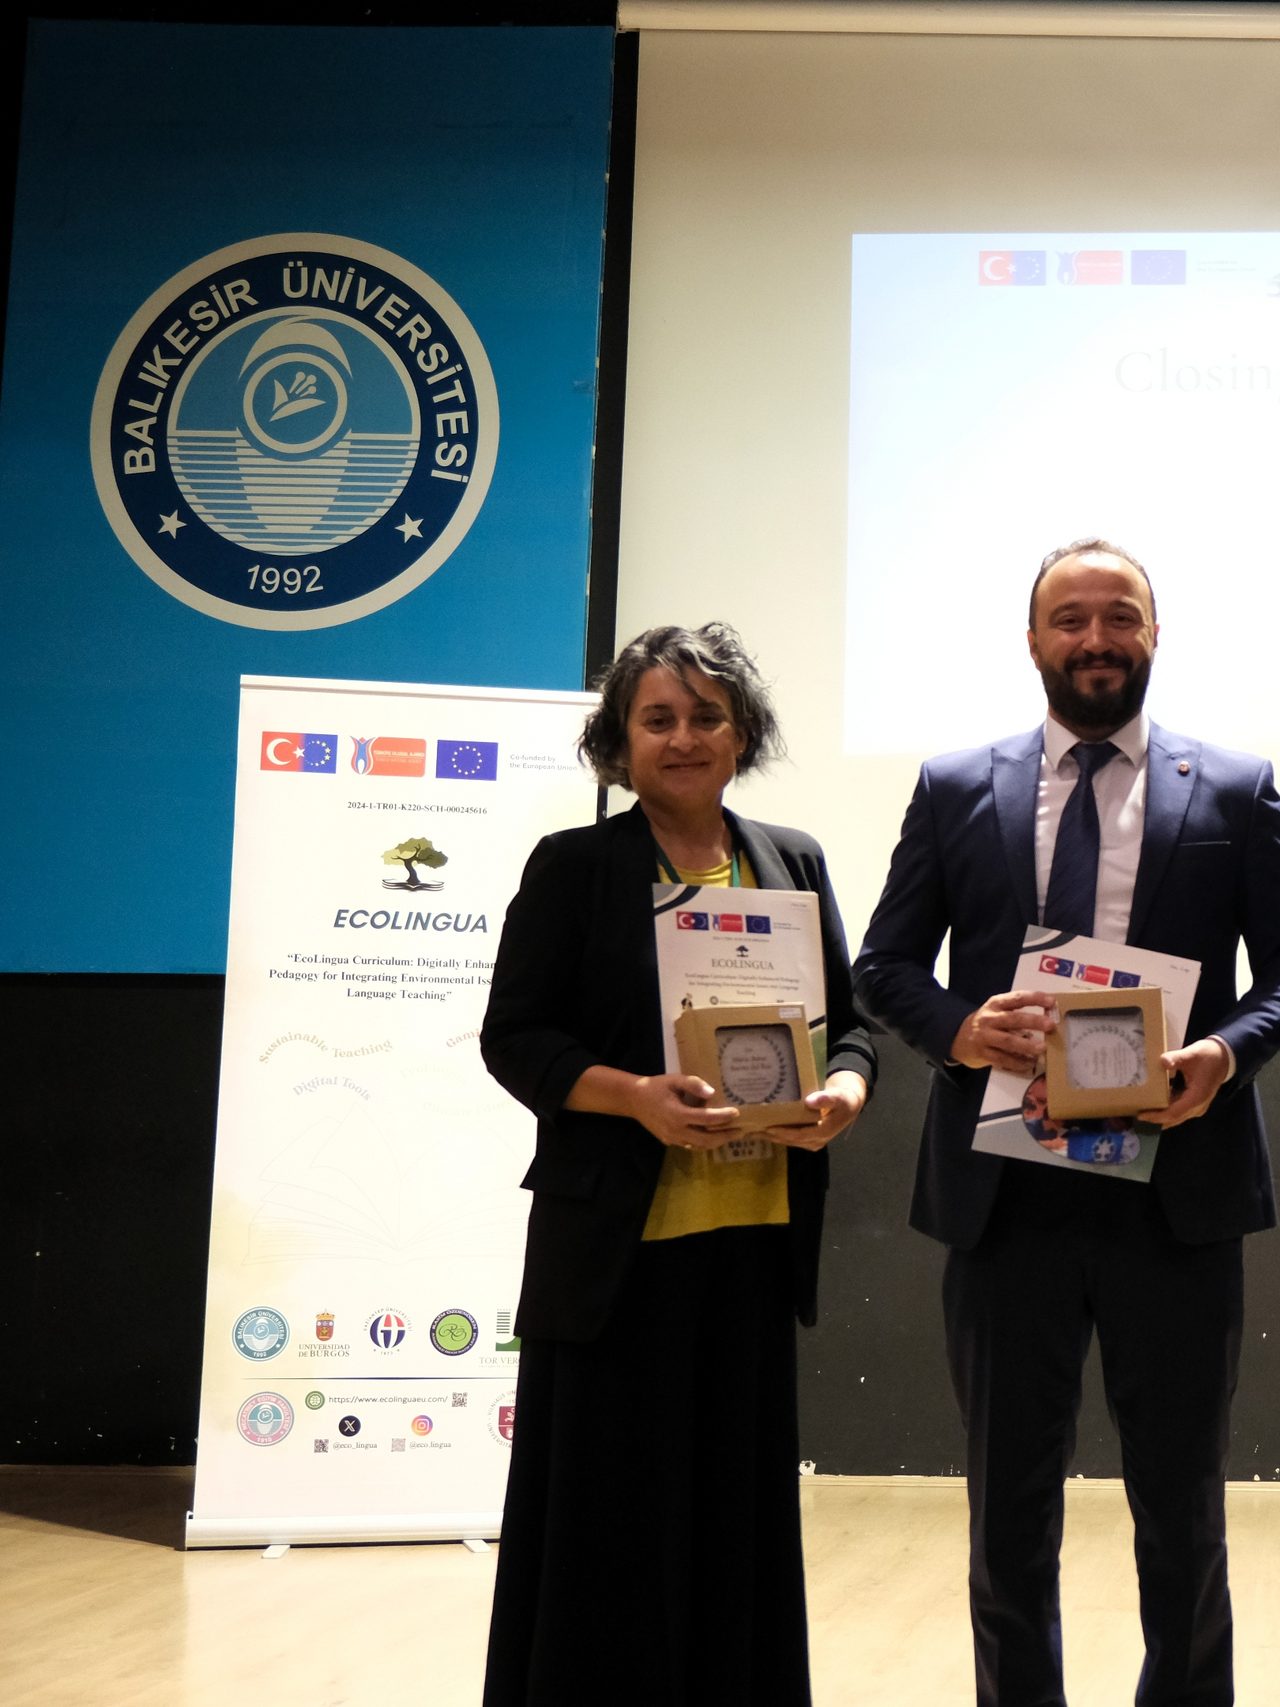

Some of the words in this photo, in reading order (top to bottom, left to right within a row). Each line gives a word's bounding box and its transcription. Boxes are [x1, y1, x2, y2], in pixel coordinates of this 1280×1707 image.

[123, 277, 259, 475] BALIKESİR
[283, 261, 469, 484] ÜNİVERSİTESİ
[247, 564, 324, 595] 1992
[333, 909, 488, 933] ECOLINGUA
[353, 955, 413, 967] Curriculum:
[417, 958, 460, 970] Digitally
[712, 957, 774, 970] ECOLINGUA
[269, 969, 319, 982] Pedagogy
[323, 971, 338, 980] for
[341, 972, 397, 983] Integrating
[401, 973, 474, 985] Environmental
[347, 988, 396, 999] Language
[259, 1031, 328, 1063] Sustainable
[332, 1039, 393, 1058] Teaching
[292, 1076, 338, 1096] Digital
[342, 1077, 371, 1101] Tools
[310, 1350, 350, 1358] BURGOS
[500, 1356, 520, 1364] VER
[328, 1395, 449, 1405] https://www.ecolinguaeu.com/
[332, 1440, 378, 1450] @eco_lingua
